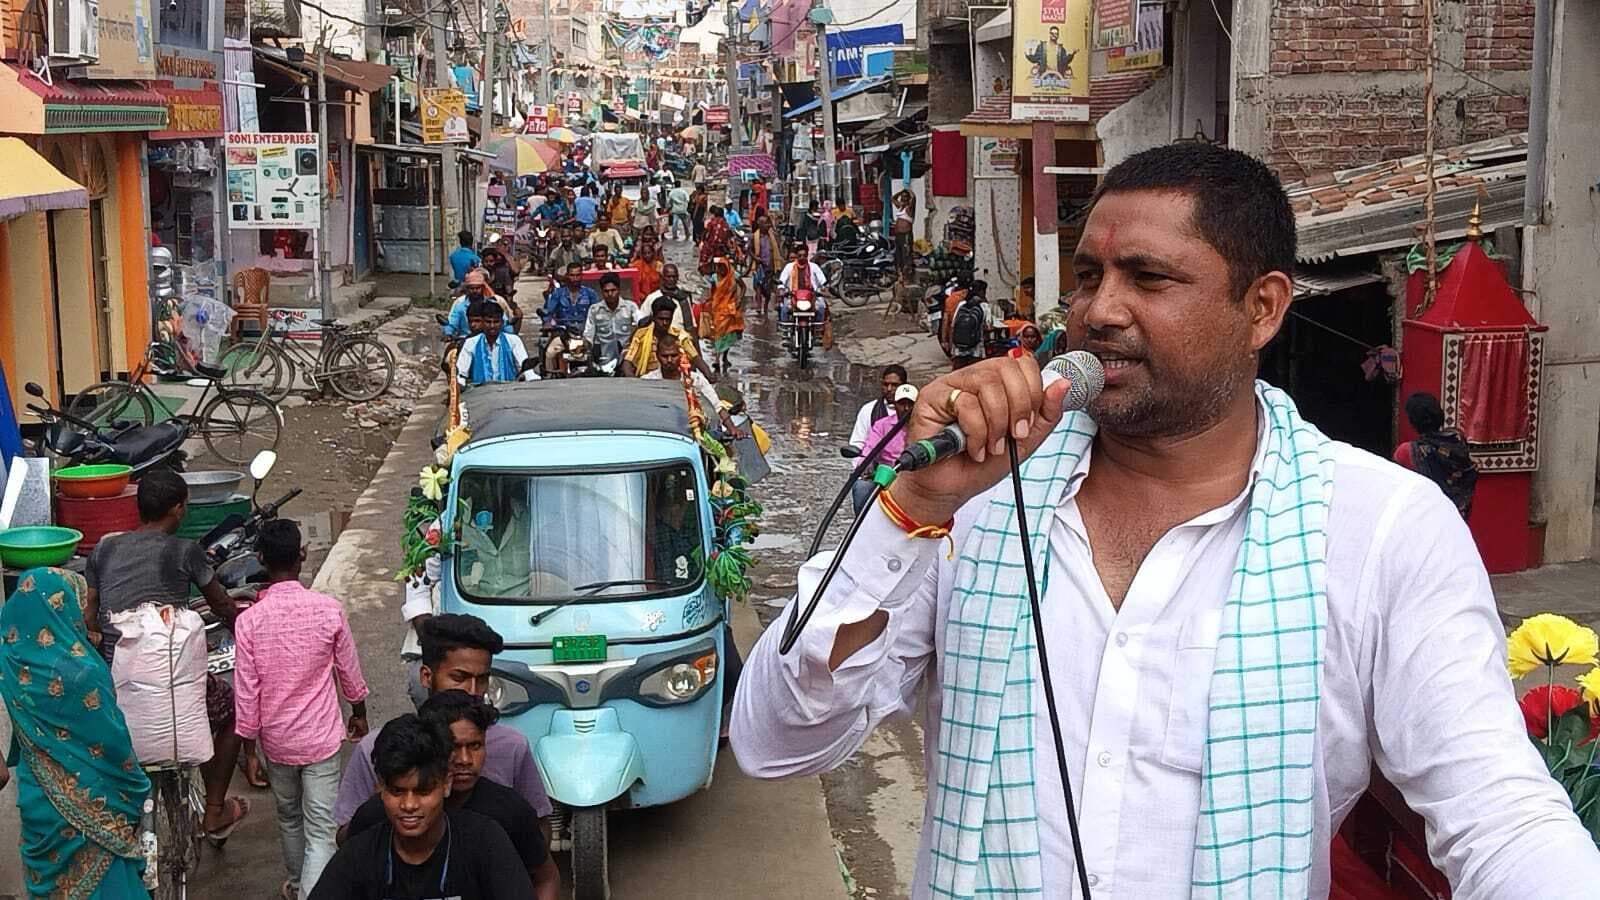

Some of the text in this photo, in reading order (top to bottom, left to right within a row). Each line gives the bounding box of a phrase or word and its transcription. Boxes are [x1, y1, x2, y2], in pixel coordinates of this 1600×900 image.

[1042, 7, 1065, 16] STYLE
[229, 134, 316, 144] SONI ENTERPRISES
